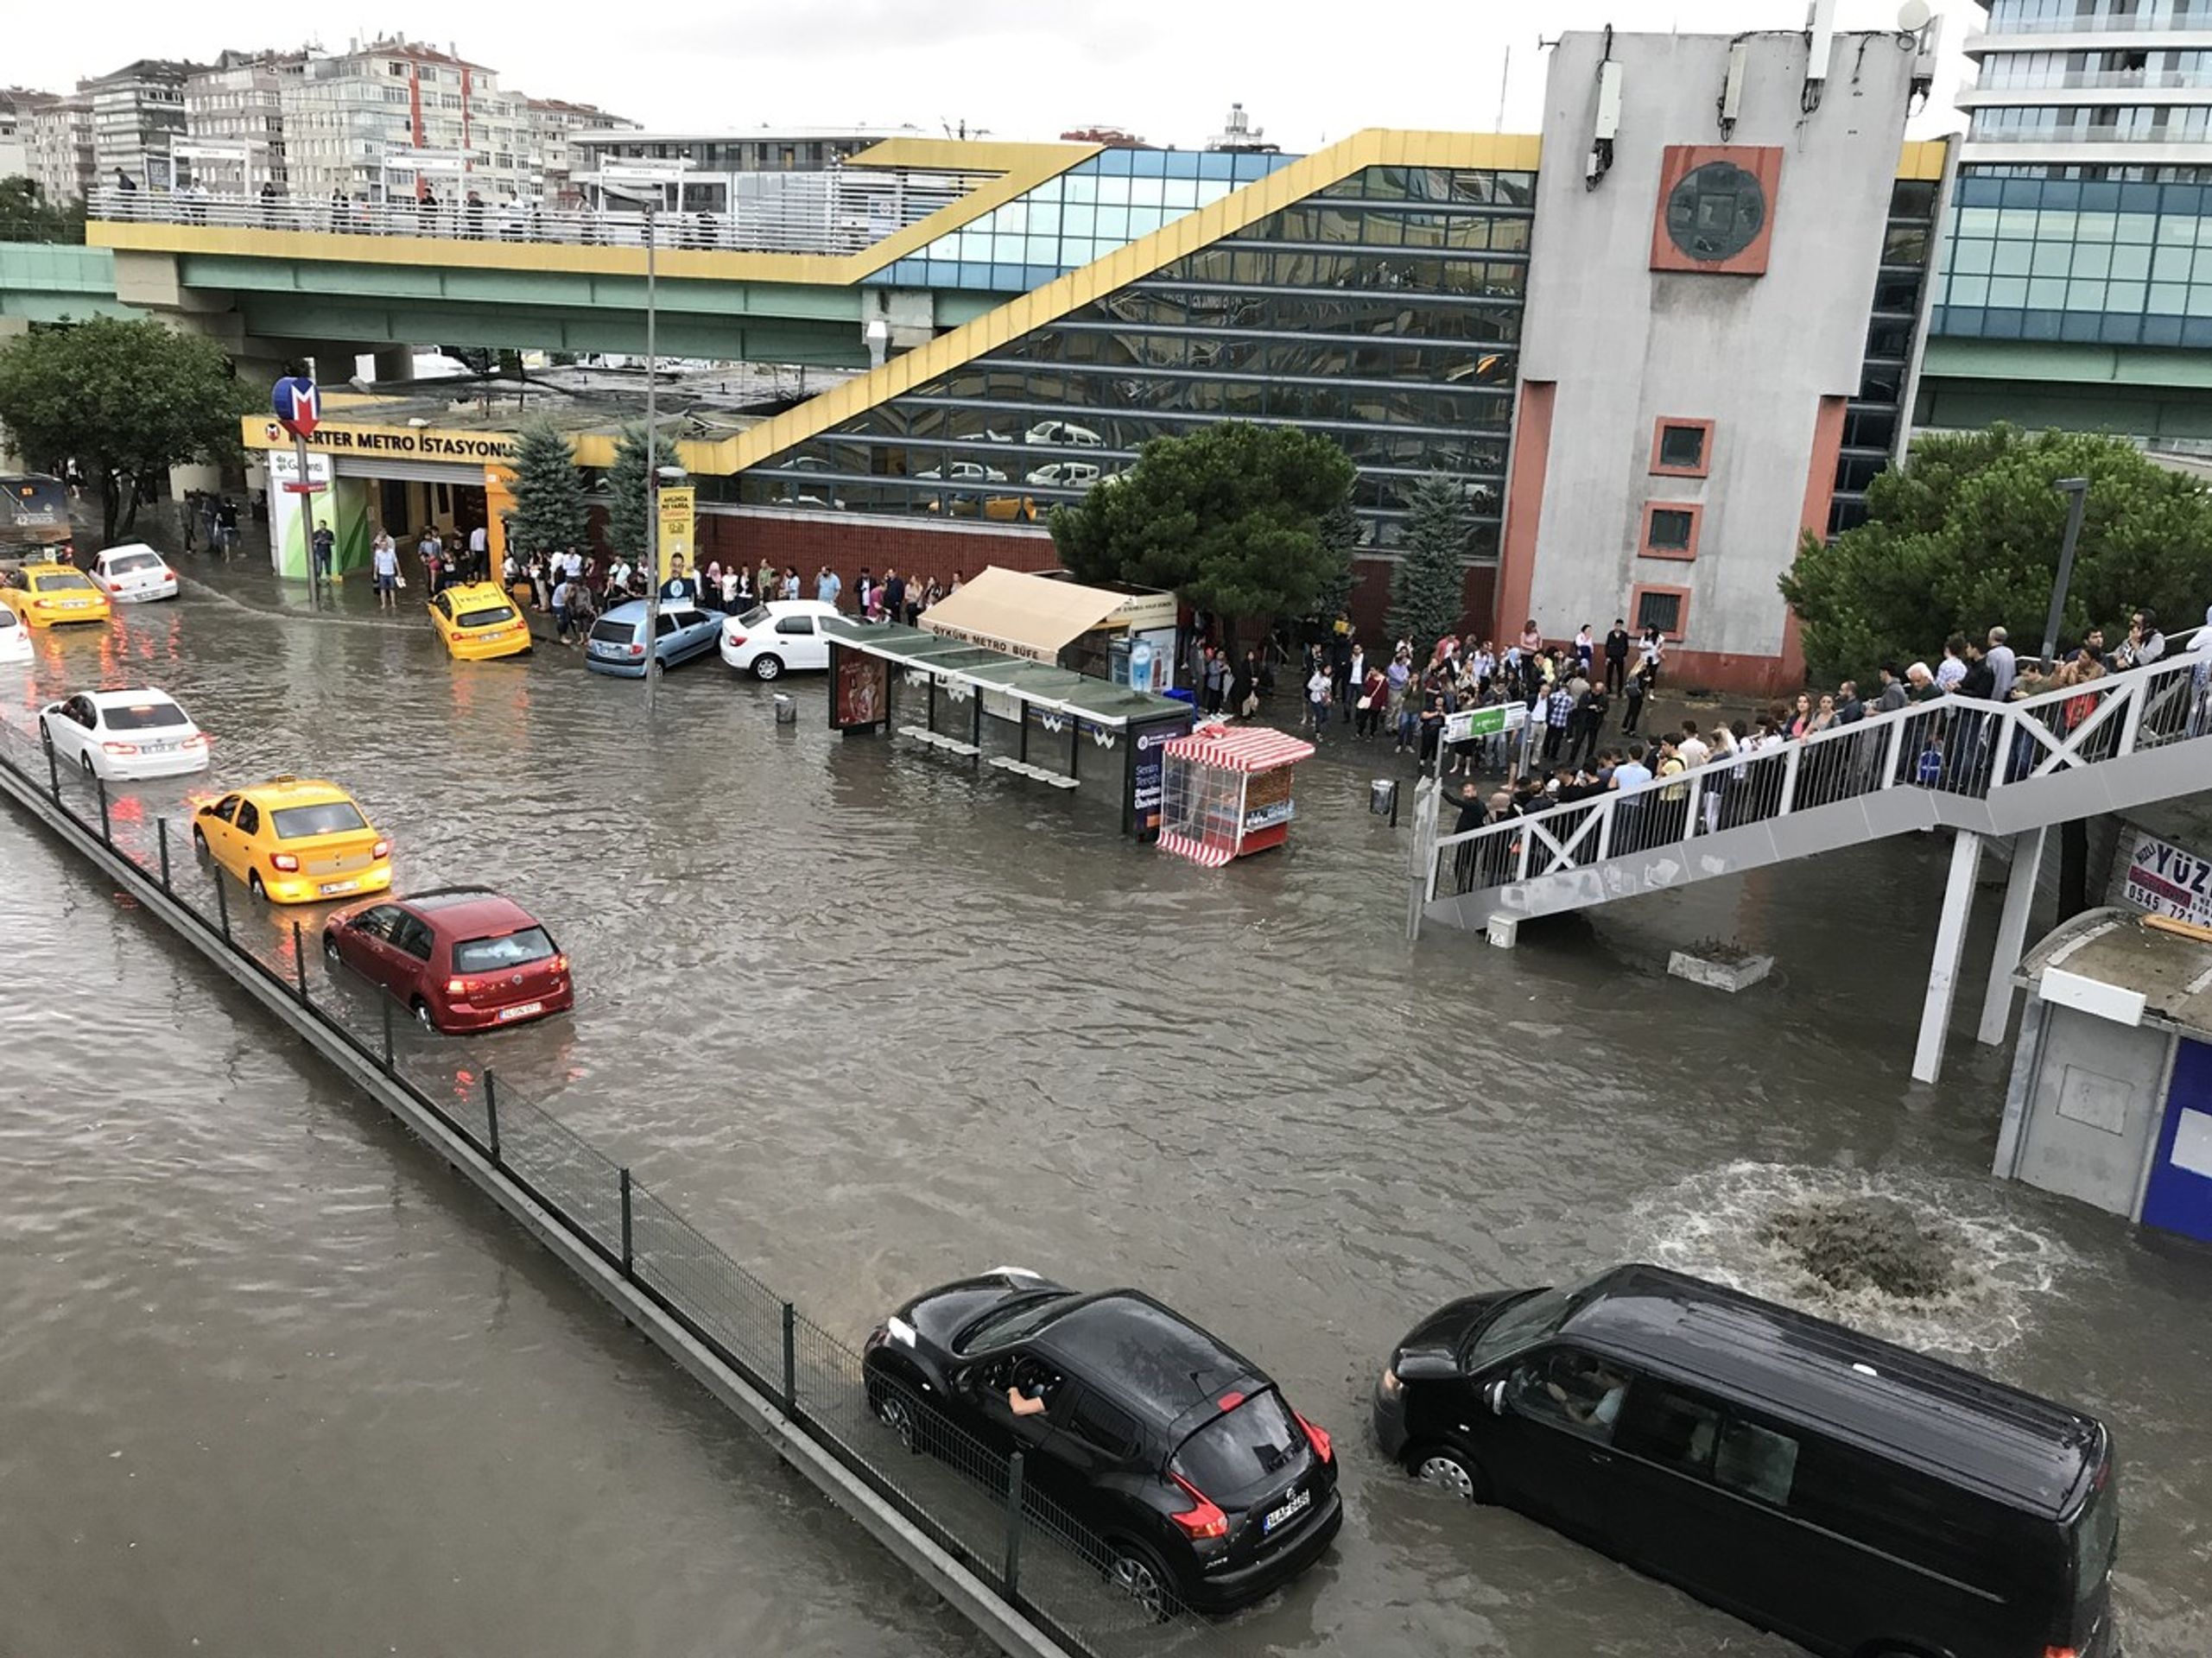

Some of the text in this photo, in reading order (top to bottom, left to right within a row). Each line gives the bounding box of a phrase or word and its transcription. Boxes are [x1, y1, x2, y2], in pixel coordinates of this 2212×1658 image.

[358, 433, 415, 451] METRO
[973, 636, 1006, 651] METRO
[1012, 646, 1038, 660] BÜFE
[2157, 844, 2212, 898] YÜZ
[2129, 884, 2160, 910] 0545
[2170, 904, 2193, 923] 721
